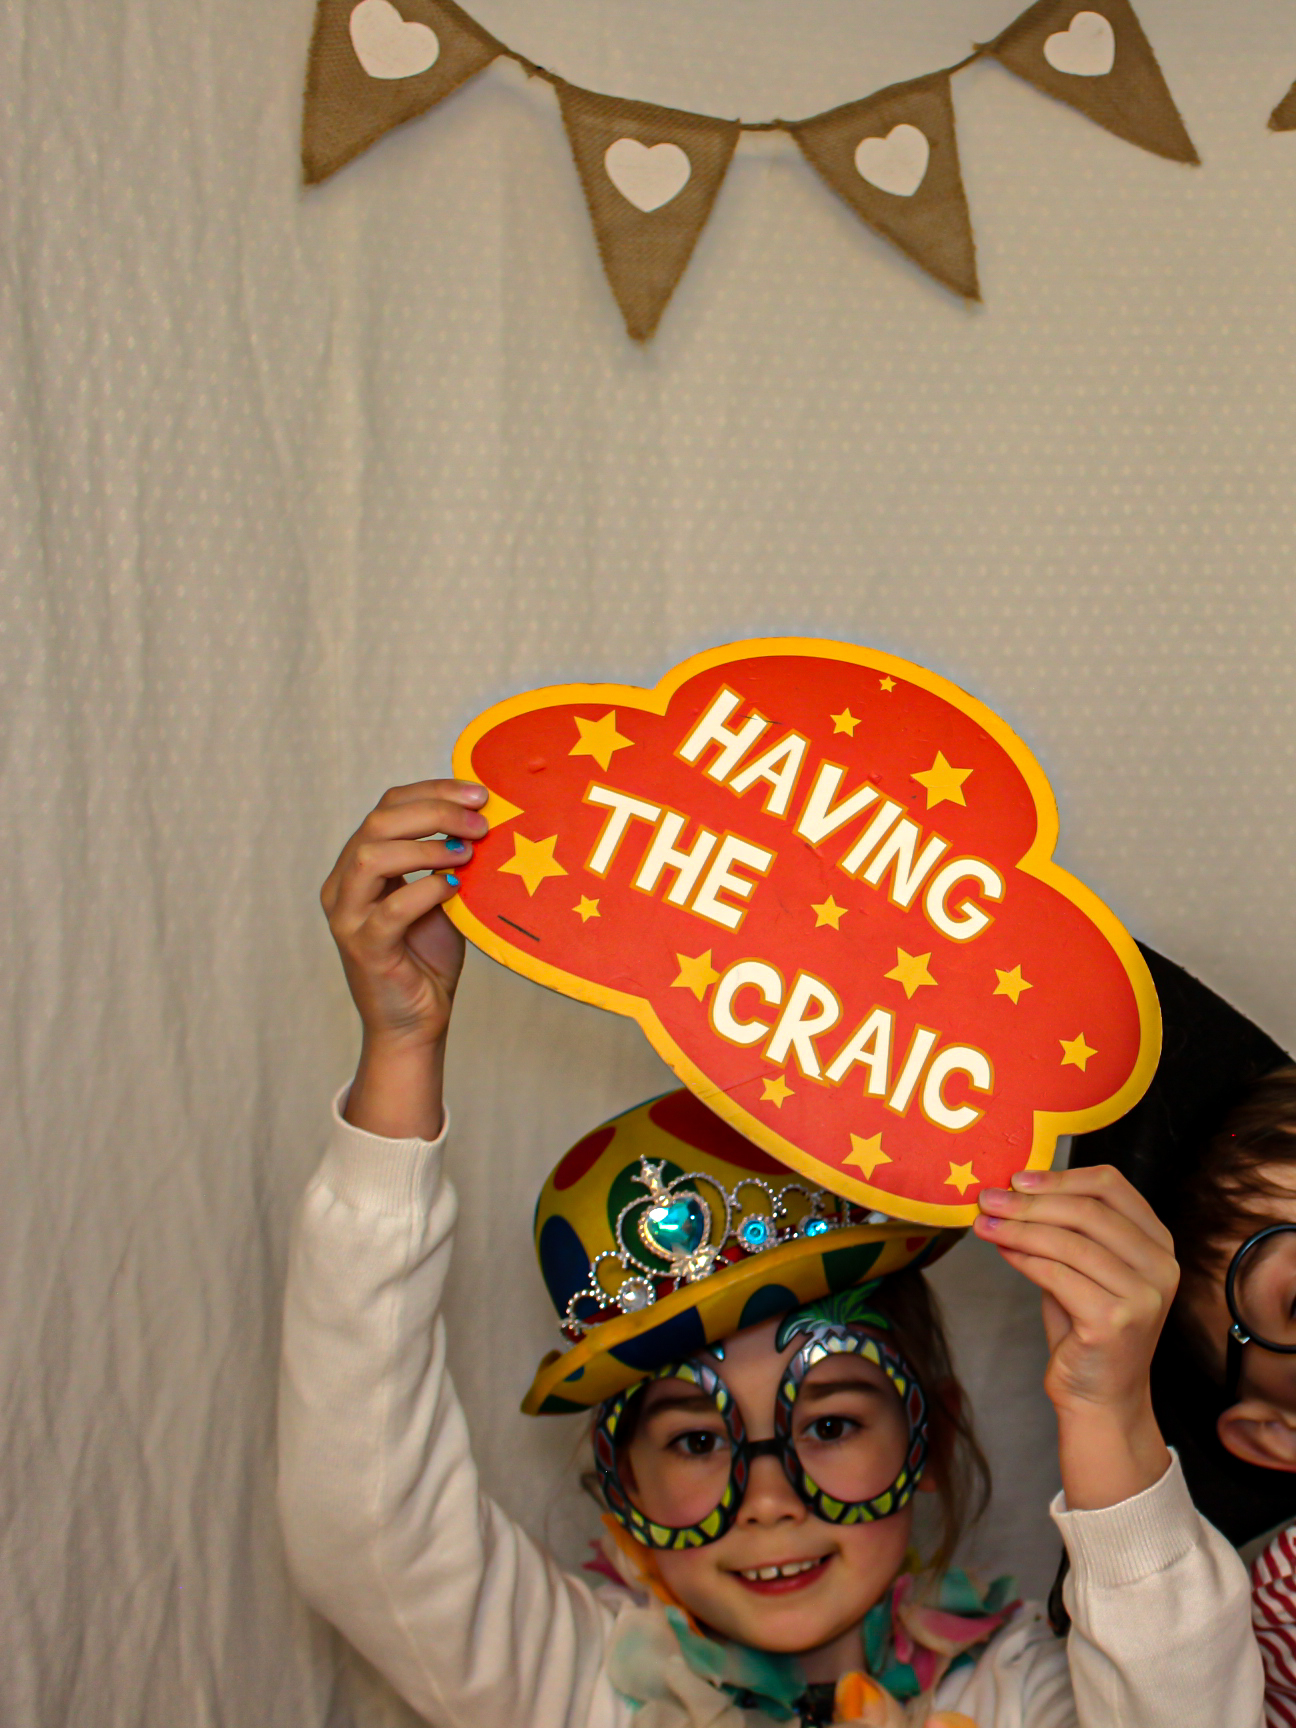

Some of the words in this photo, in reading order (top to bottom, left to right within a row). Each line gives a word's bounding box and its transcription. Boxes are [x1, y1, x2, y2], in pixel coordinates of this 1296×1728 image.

[584, 783, 776, 931] THE
[677, 687, 1005, 942] HAVING
[710, 959, 993, 1131] CRAIC
